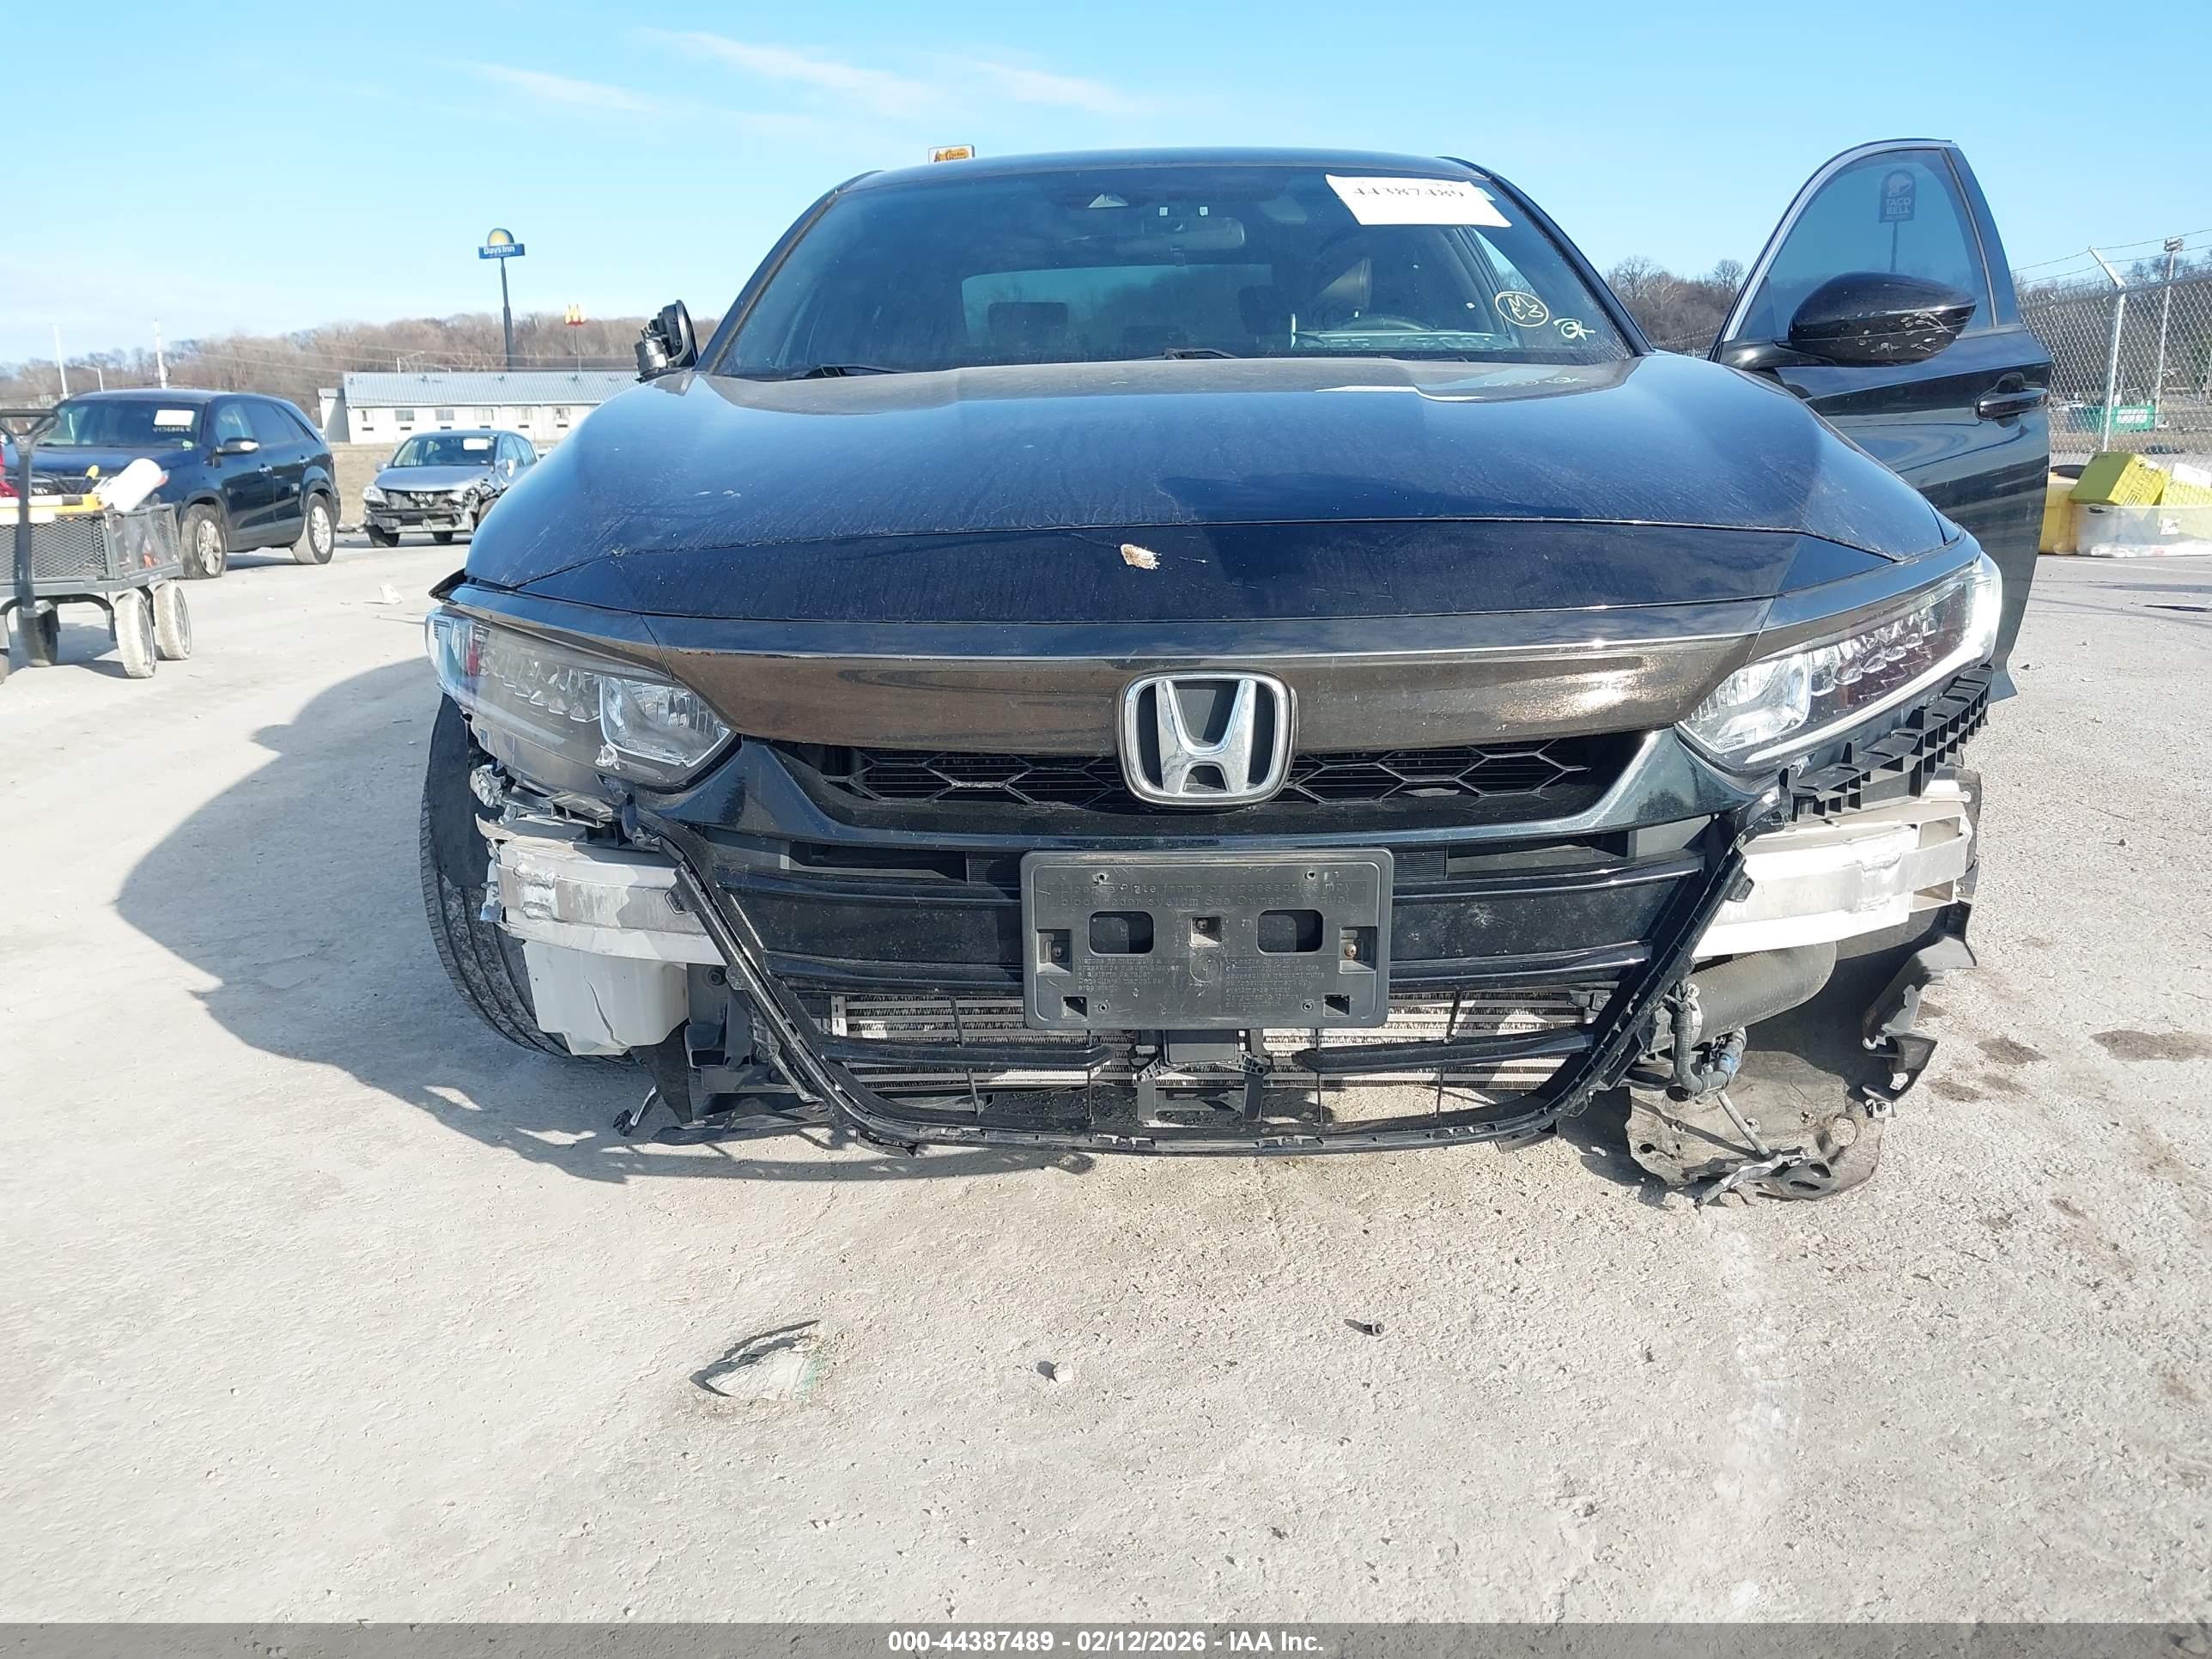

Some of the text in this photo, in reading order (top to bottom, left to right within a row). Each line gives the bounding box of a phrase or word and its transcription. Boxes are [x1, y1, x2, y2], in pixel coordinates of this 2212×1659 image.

[1885, 198, 1911, 207] TACO
[1886, 205, 1911, 215] BELL
[483, 246, 502, 255] Days
[1120, 884, 1157, 894] Plate
[1163, 883, 1202, 894] frame
